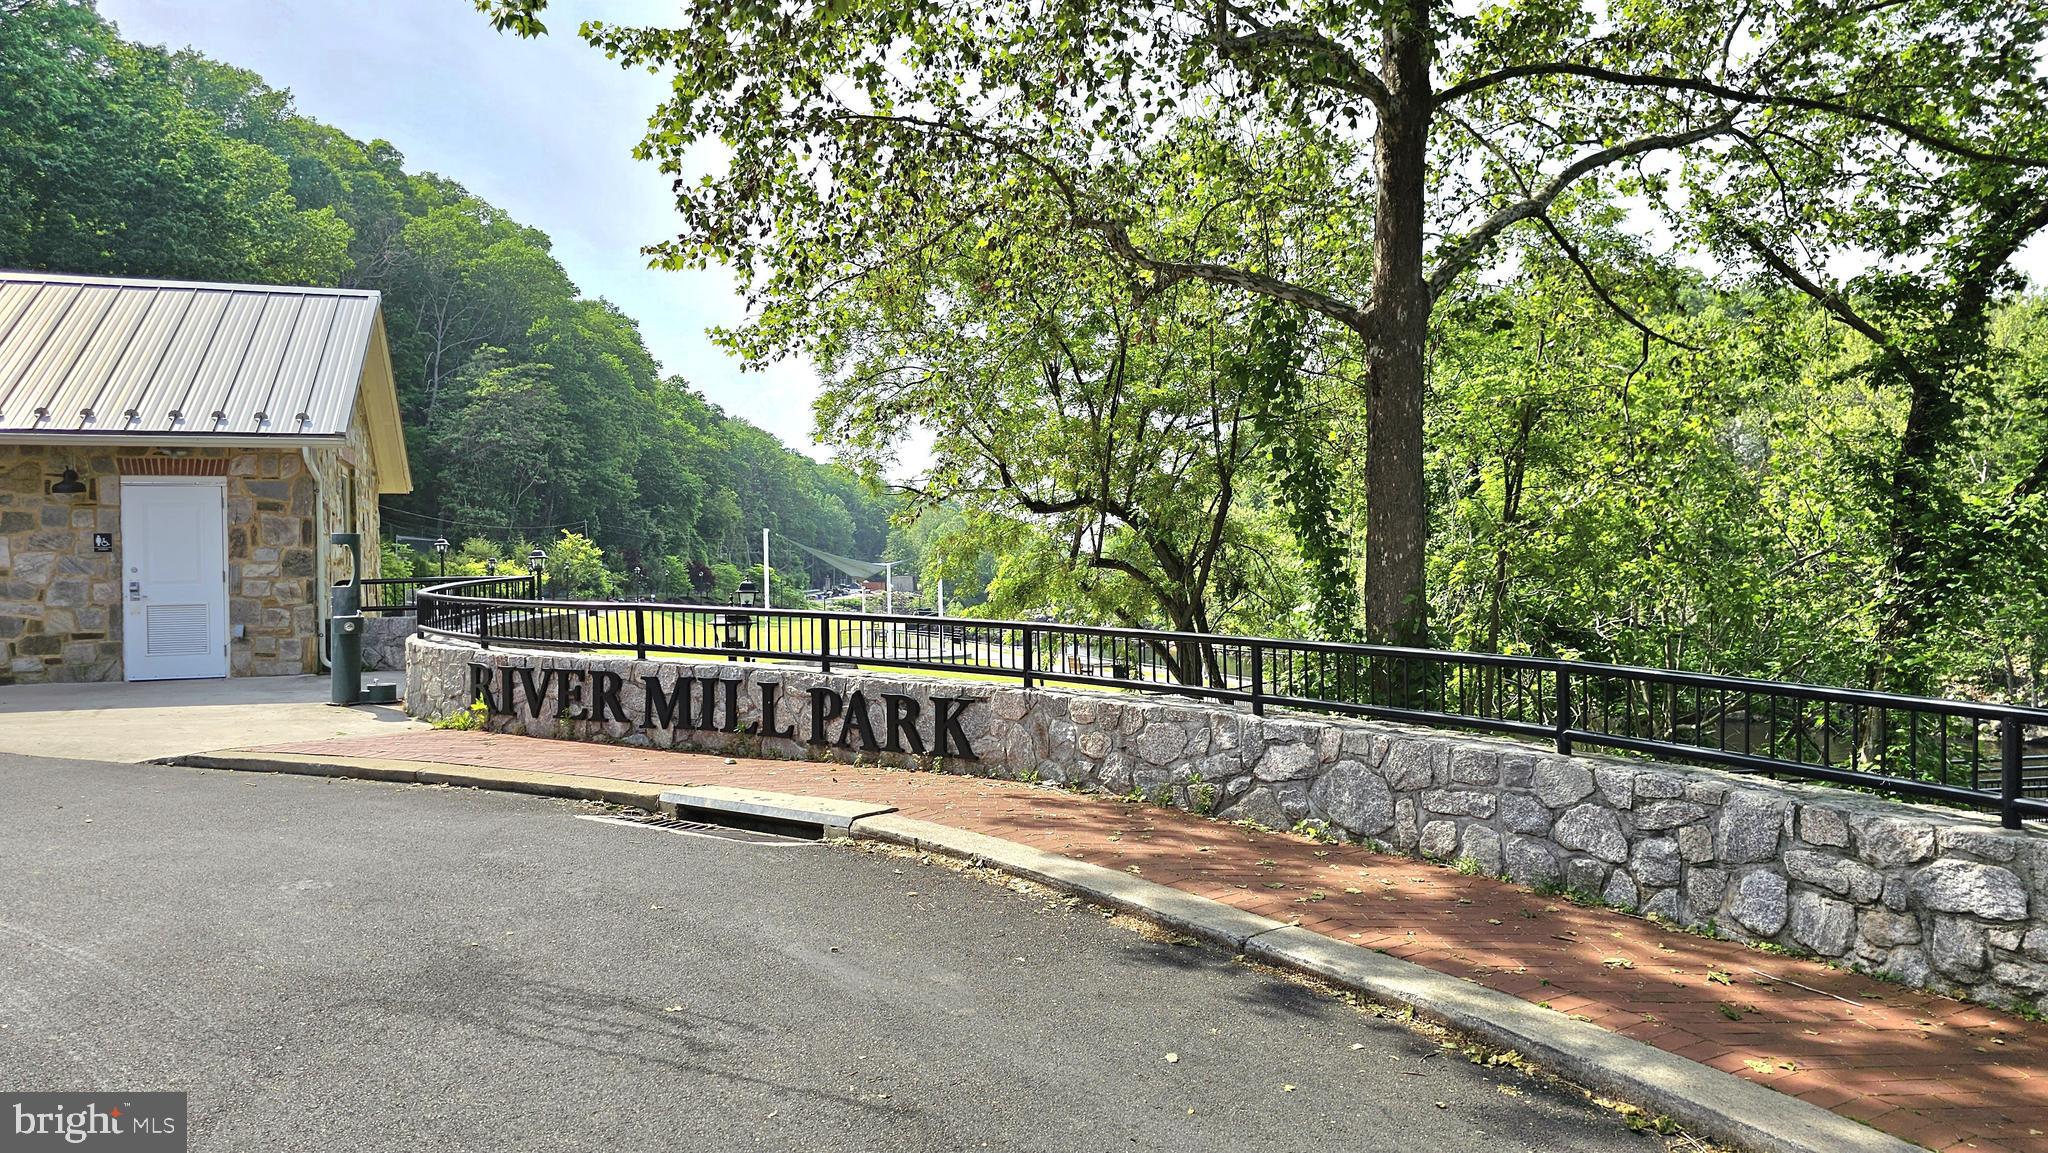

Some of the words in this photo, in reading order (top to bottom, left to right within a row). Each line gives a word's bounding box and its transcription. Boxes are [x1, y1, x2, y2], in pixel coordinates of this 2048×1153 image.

[468, 662, 630, 723] RIVER
[640, 676, 795, 739] MILL
[807, 687, 981, 760] PARK
